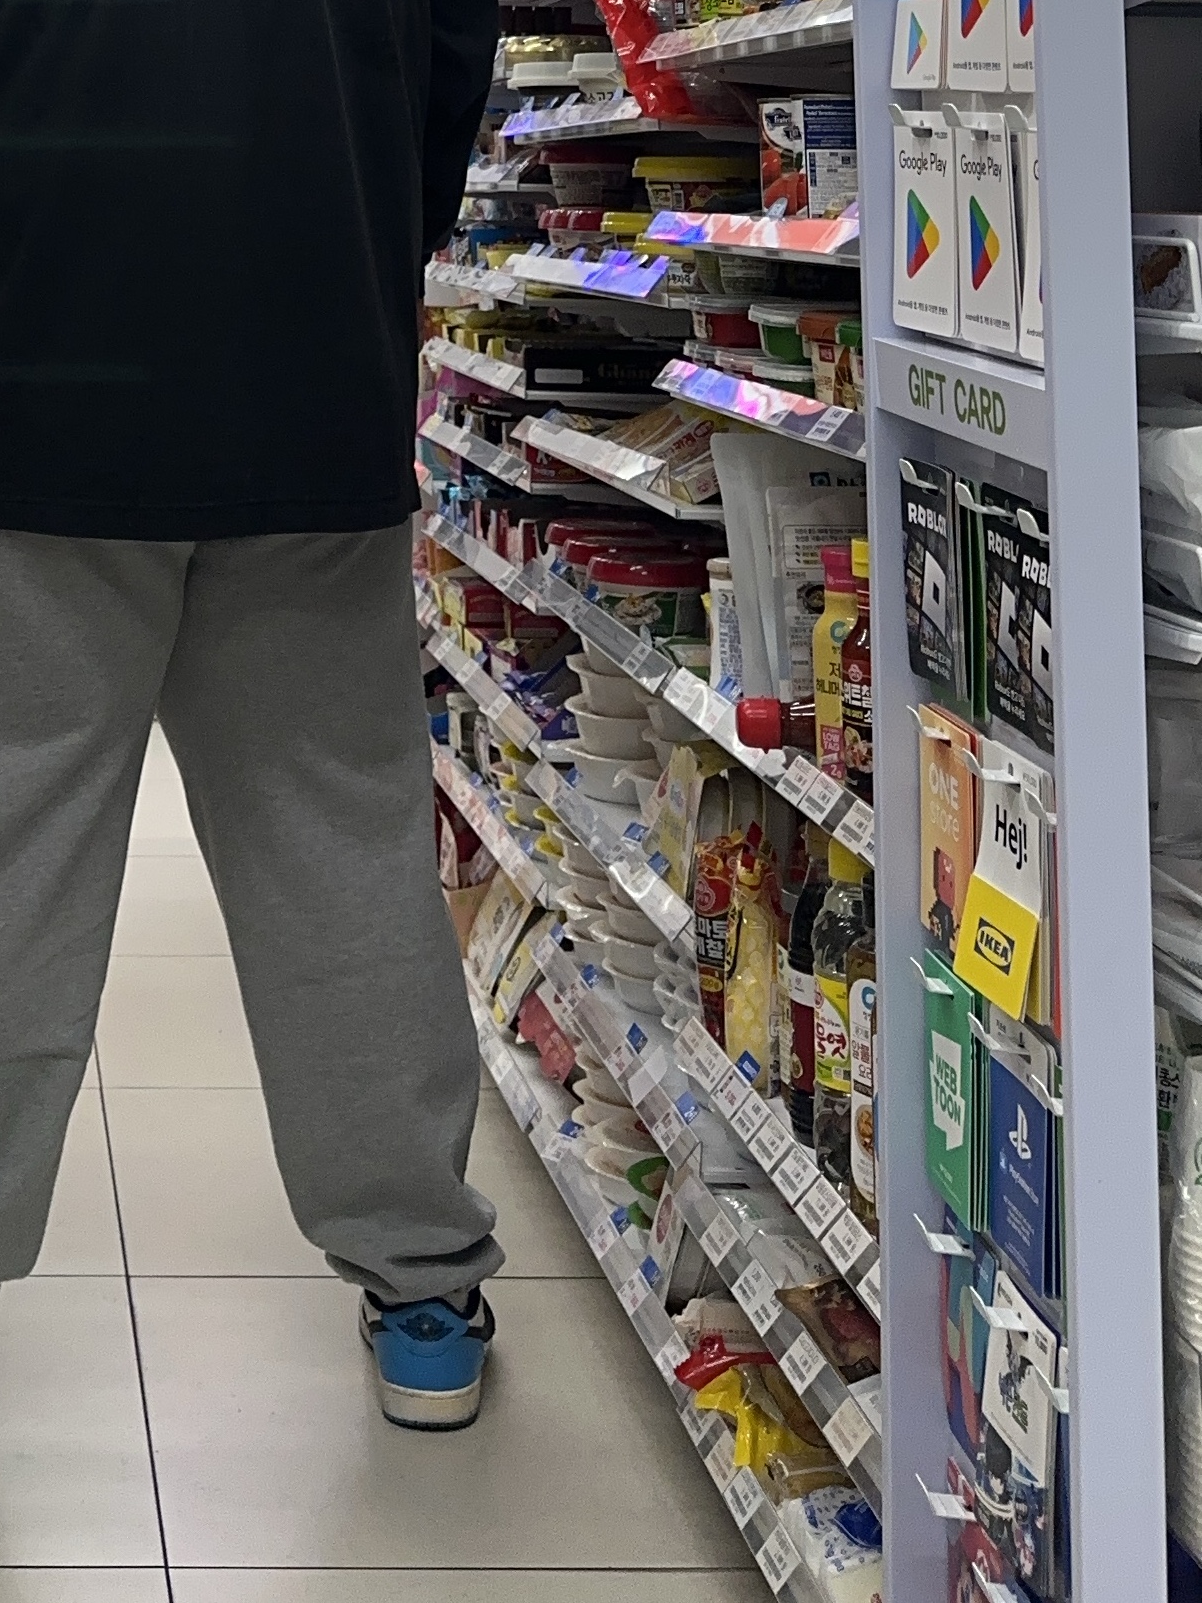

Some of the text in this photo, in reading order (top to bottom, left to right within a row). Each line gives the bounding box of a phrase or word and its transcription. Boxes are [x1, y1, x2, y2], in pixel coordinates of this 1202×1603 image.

[899, 149, 947, 177] Google Play
[960, 154, 1003, 182] Google Play
[908, 363, 1007, 436] GIFT CARD
[987, 530, 1020, 564] ROBL
[822, 732, 840, 742] LOW
[824, 742, 840, 752] TAG
[928, 762, 960, 811] ONE
[929, 800, 960, 842] store
[994, 803, 1028, 870] Hej!
[979, 930, 1010, 963] IKEA
[936, 1054, 958, 1096] WEB
[934, 1076, 962, 1127] TOON
